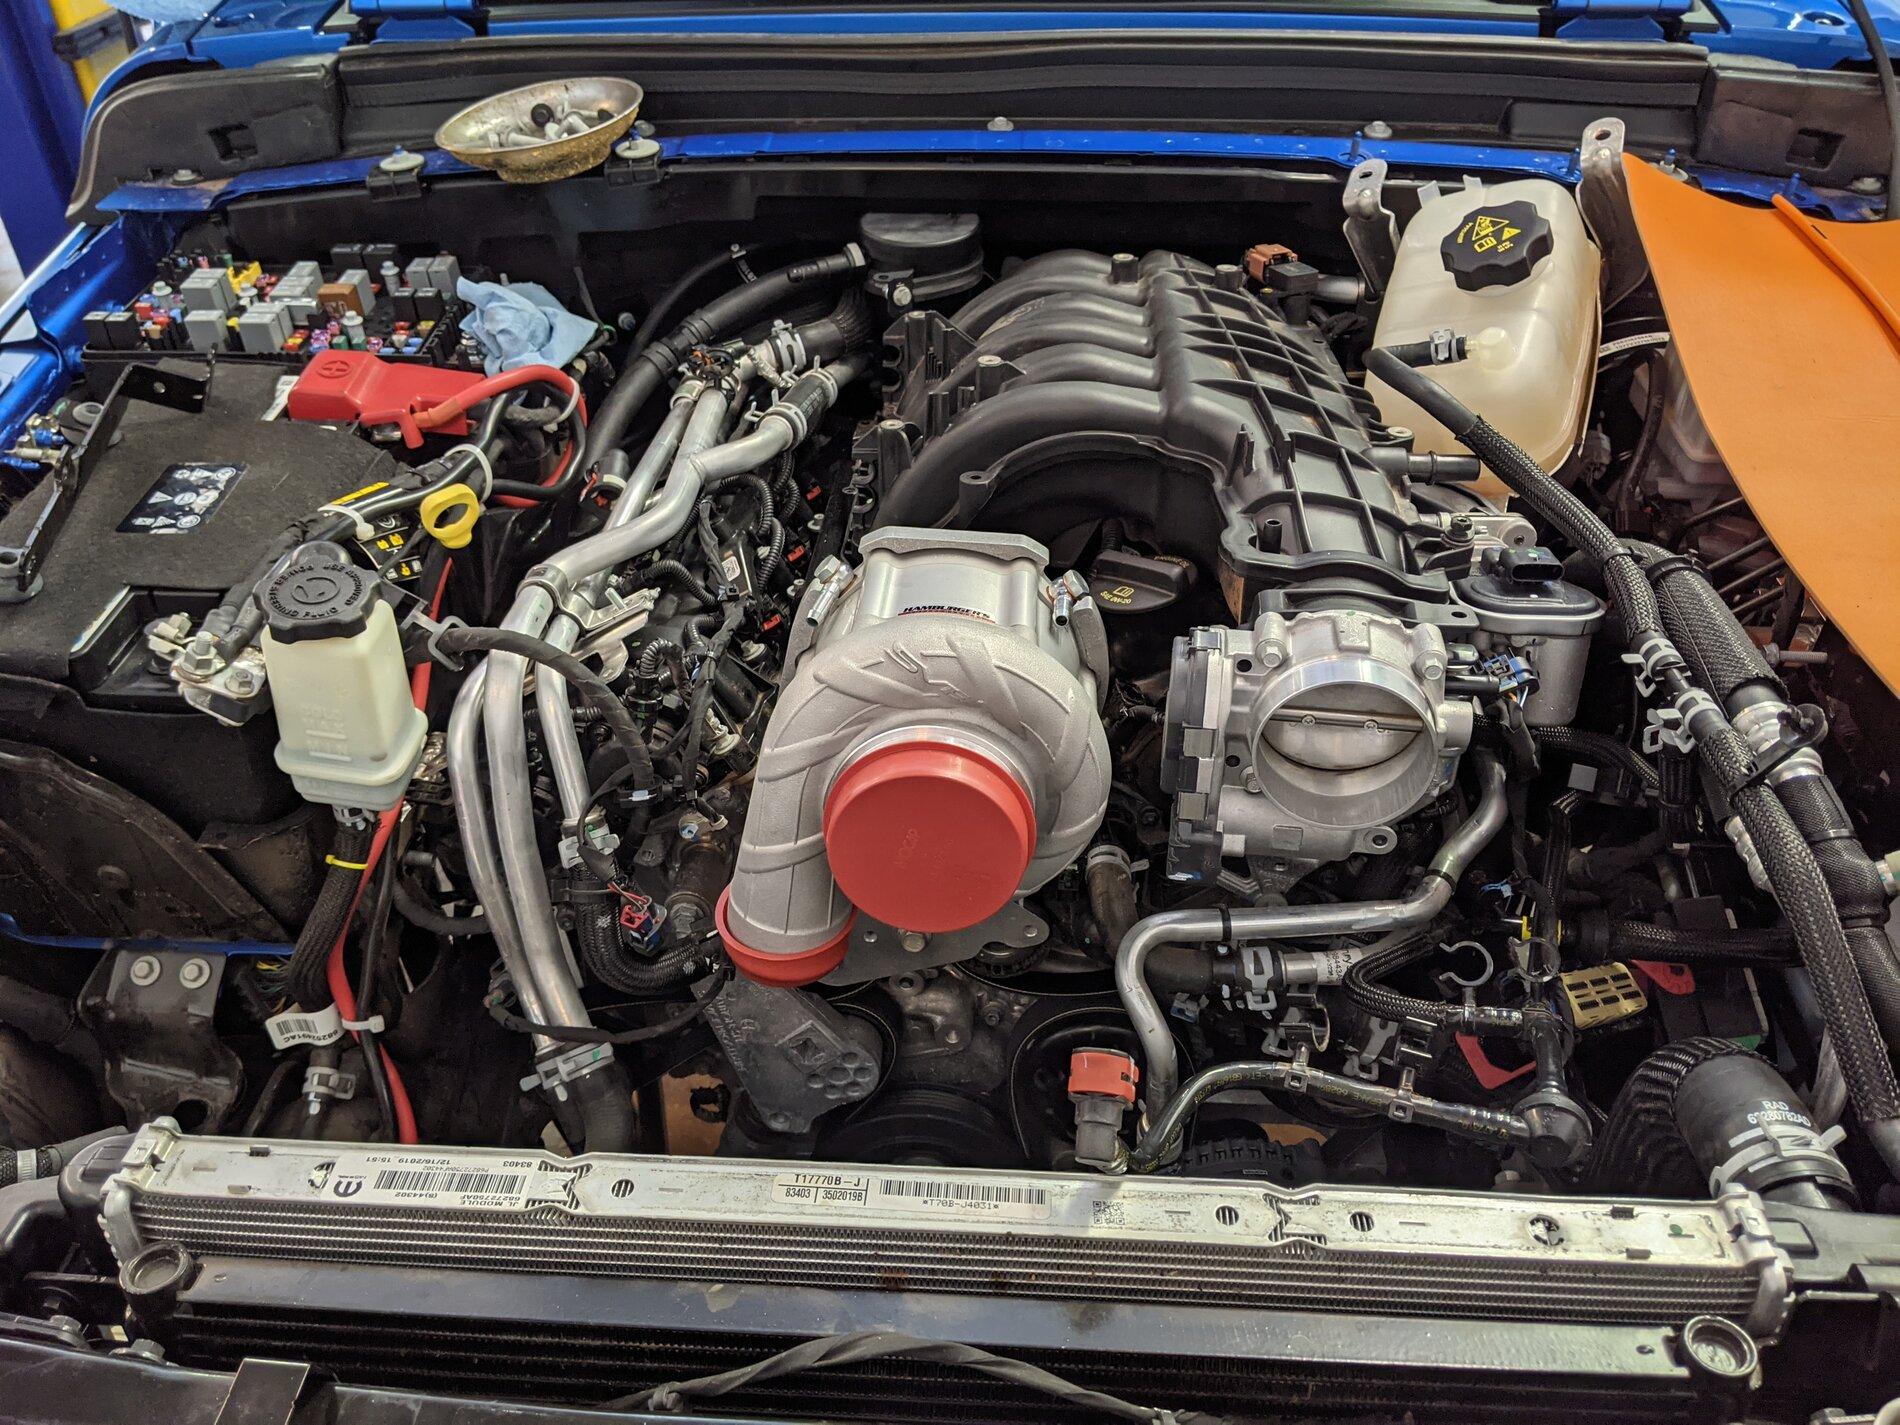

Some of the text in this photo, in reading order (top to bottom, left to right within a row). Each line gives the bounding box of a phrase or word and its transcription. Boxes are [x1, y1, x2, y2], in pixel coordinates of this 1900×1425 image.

[268, 585, 299, 618] STEERING
[1761, 1100, 1789, 1111] RAD
[398, 1157, 451, 1165] 12/16/2019
[502, 1160, 533, 1168] 83403
[785, 1187, 863, 1202] 83403 3502019B
[460, 1199, 503, 1207] MODULE
